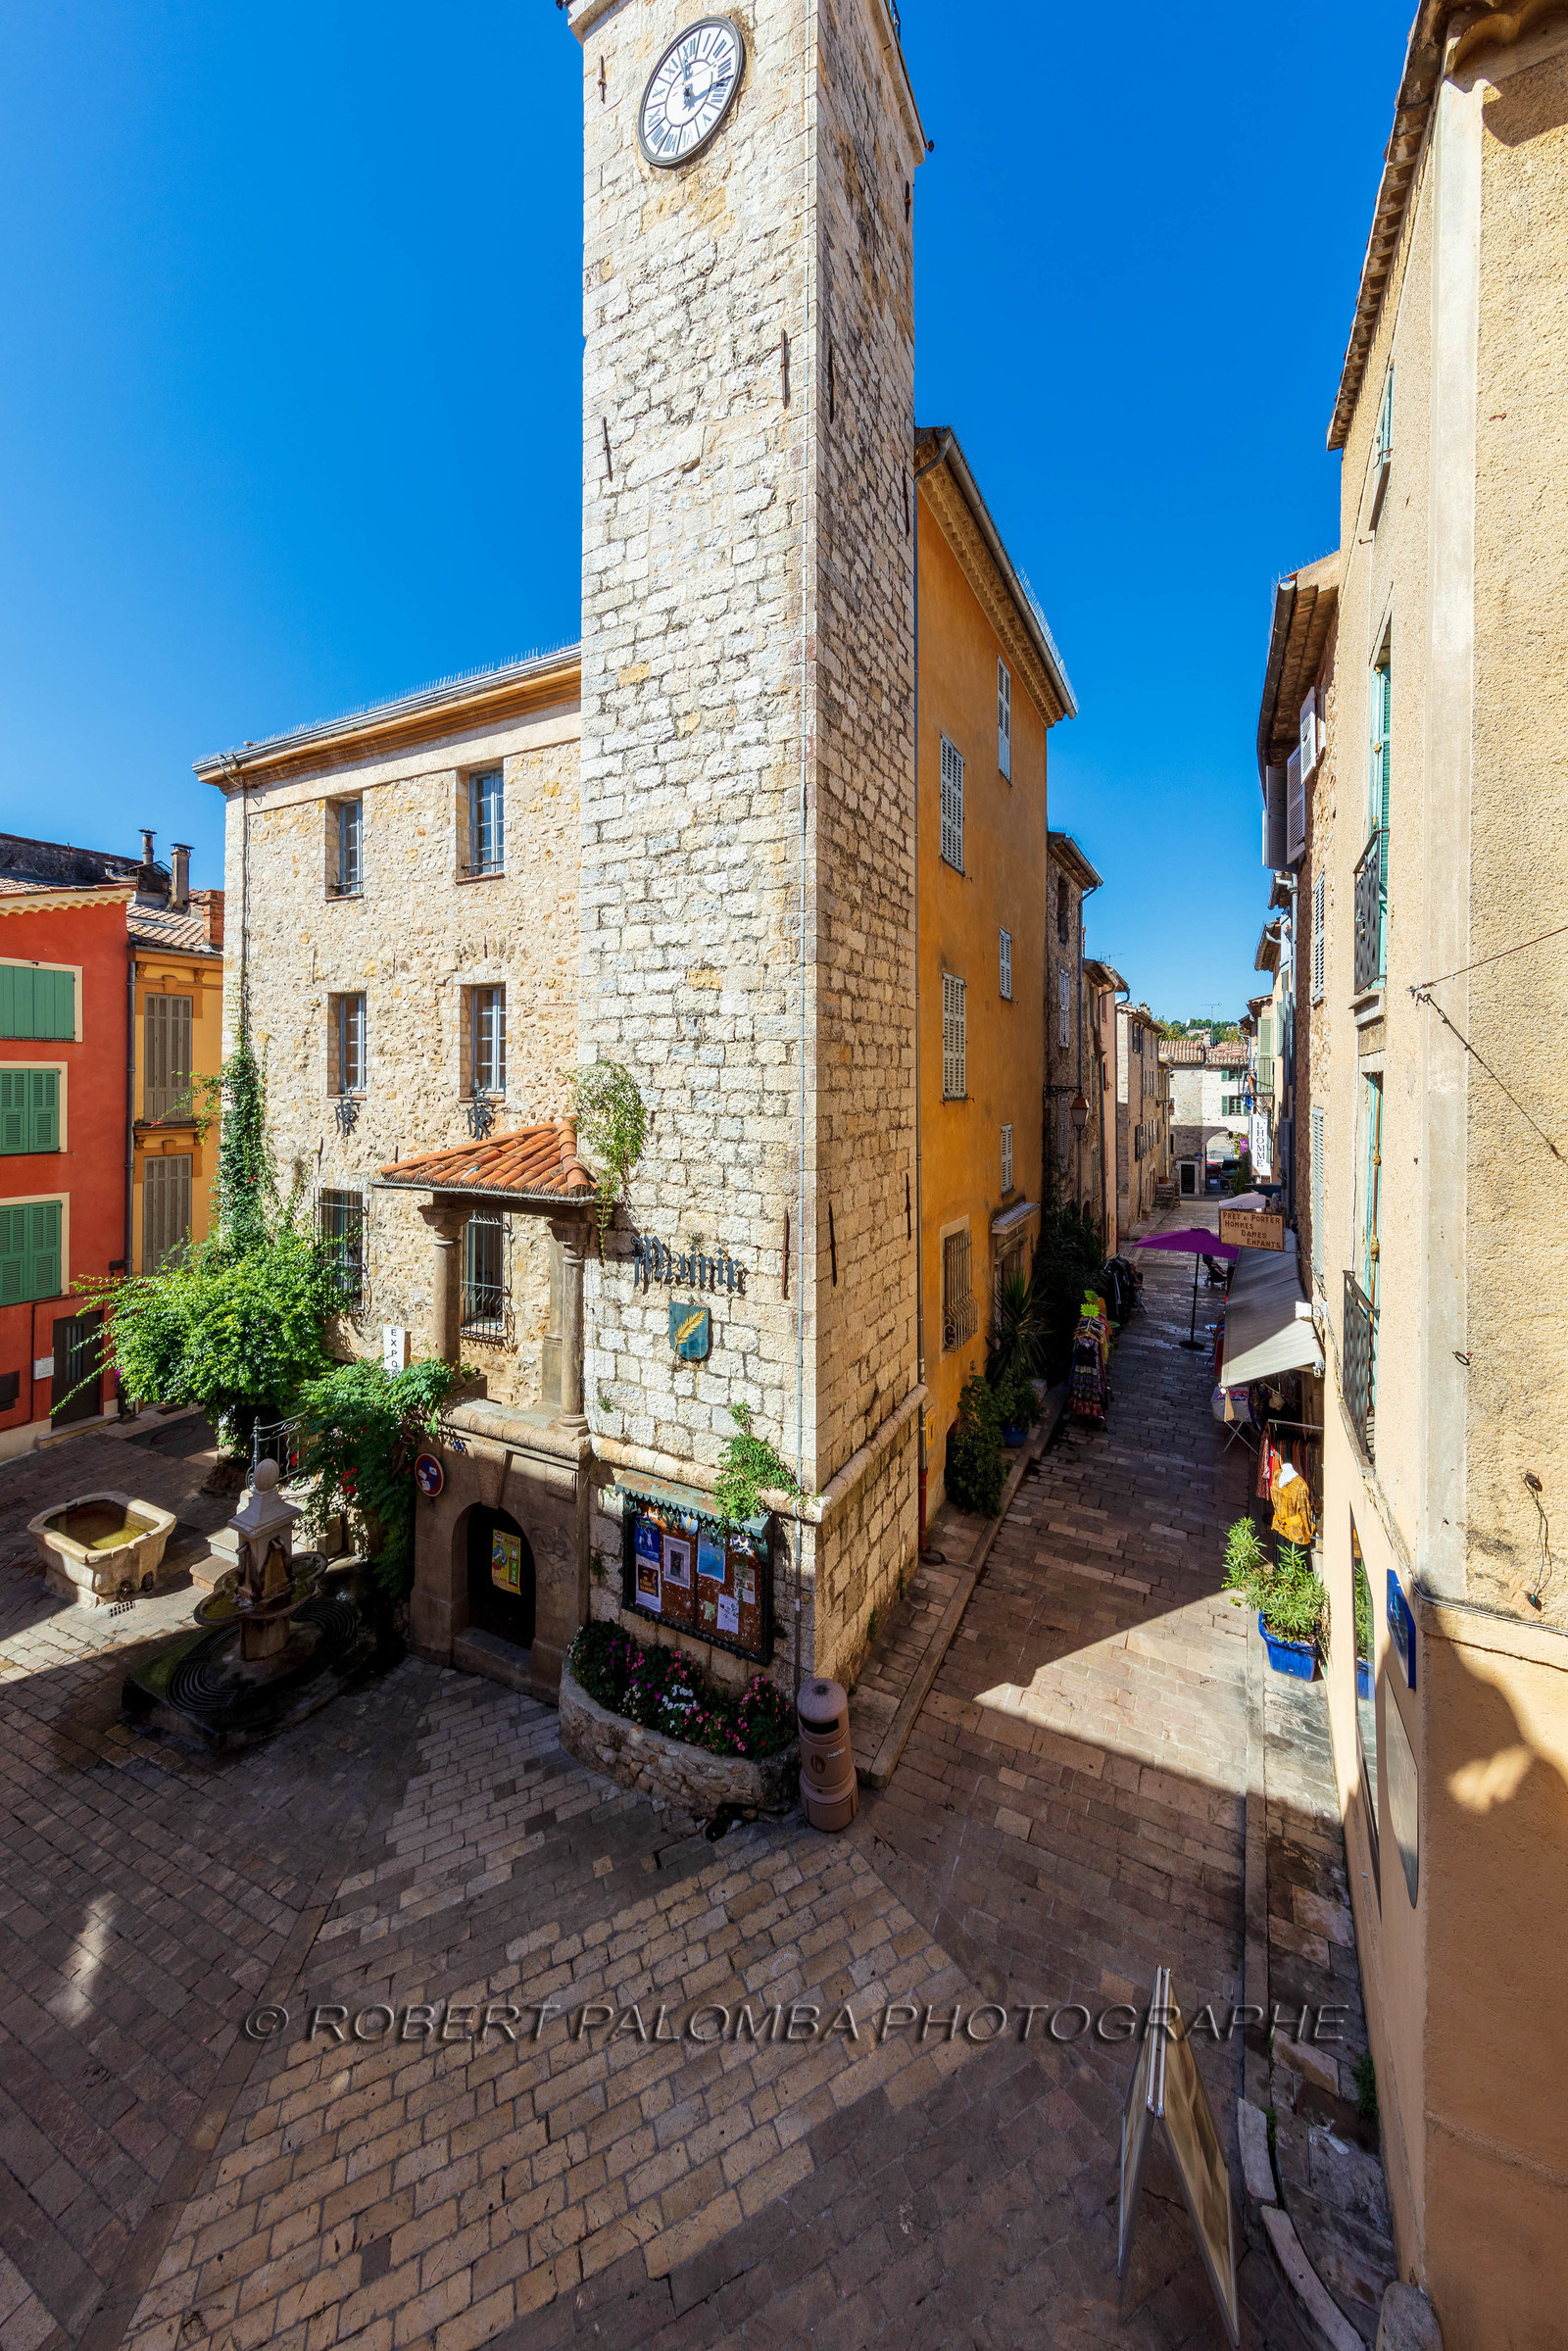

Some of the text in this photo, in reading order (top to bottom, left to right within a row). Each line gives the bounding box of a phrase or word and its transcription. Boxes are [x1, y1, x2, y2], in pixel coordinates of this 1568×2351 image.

[682, 37, 697, 59] XII
[712, 38, 727, 59] II
[663, 58, 679, 79] XI
[652, 87, 666, 98] X
[648, 107, 662, 128] IX
[702, 113, 712, 127] V
[682, 130, 694, 148] VI
[1255, 1121, 1266, 1167] L'HOMME
[1224, 1220, 1254, 1230] HOMMES
[1250, 1214, 1281, 1224] PORTER
[1241, 1229, 1267, 1239] DAMES
[1247, 1238, 1281, 1249] ENFANTS
[631, 1234, 742, 1289] Mairie
